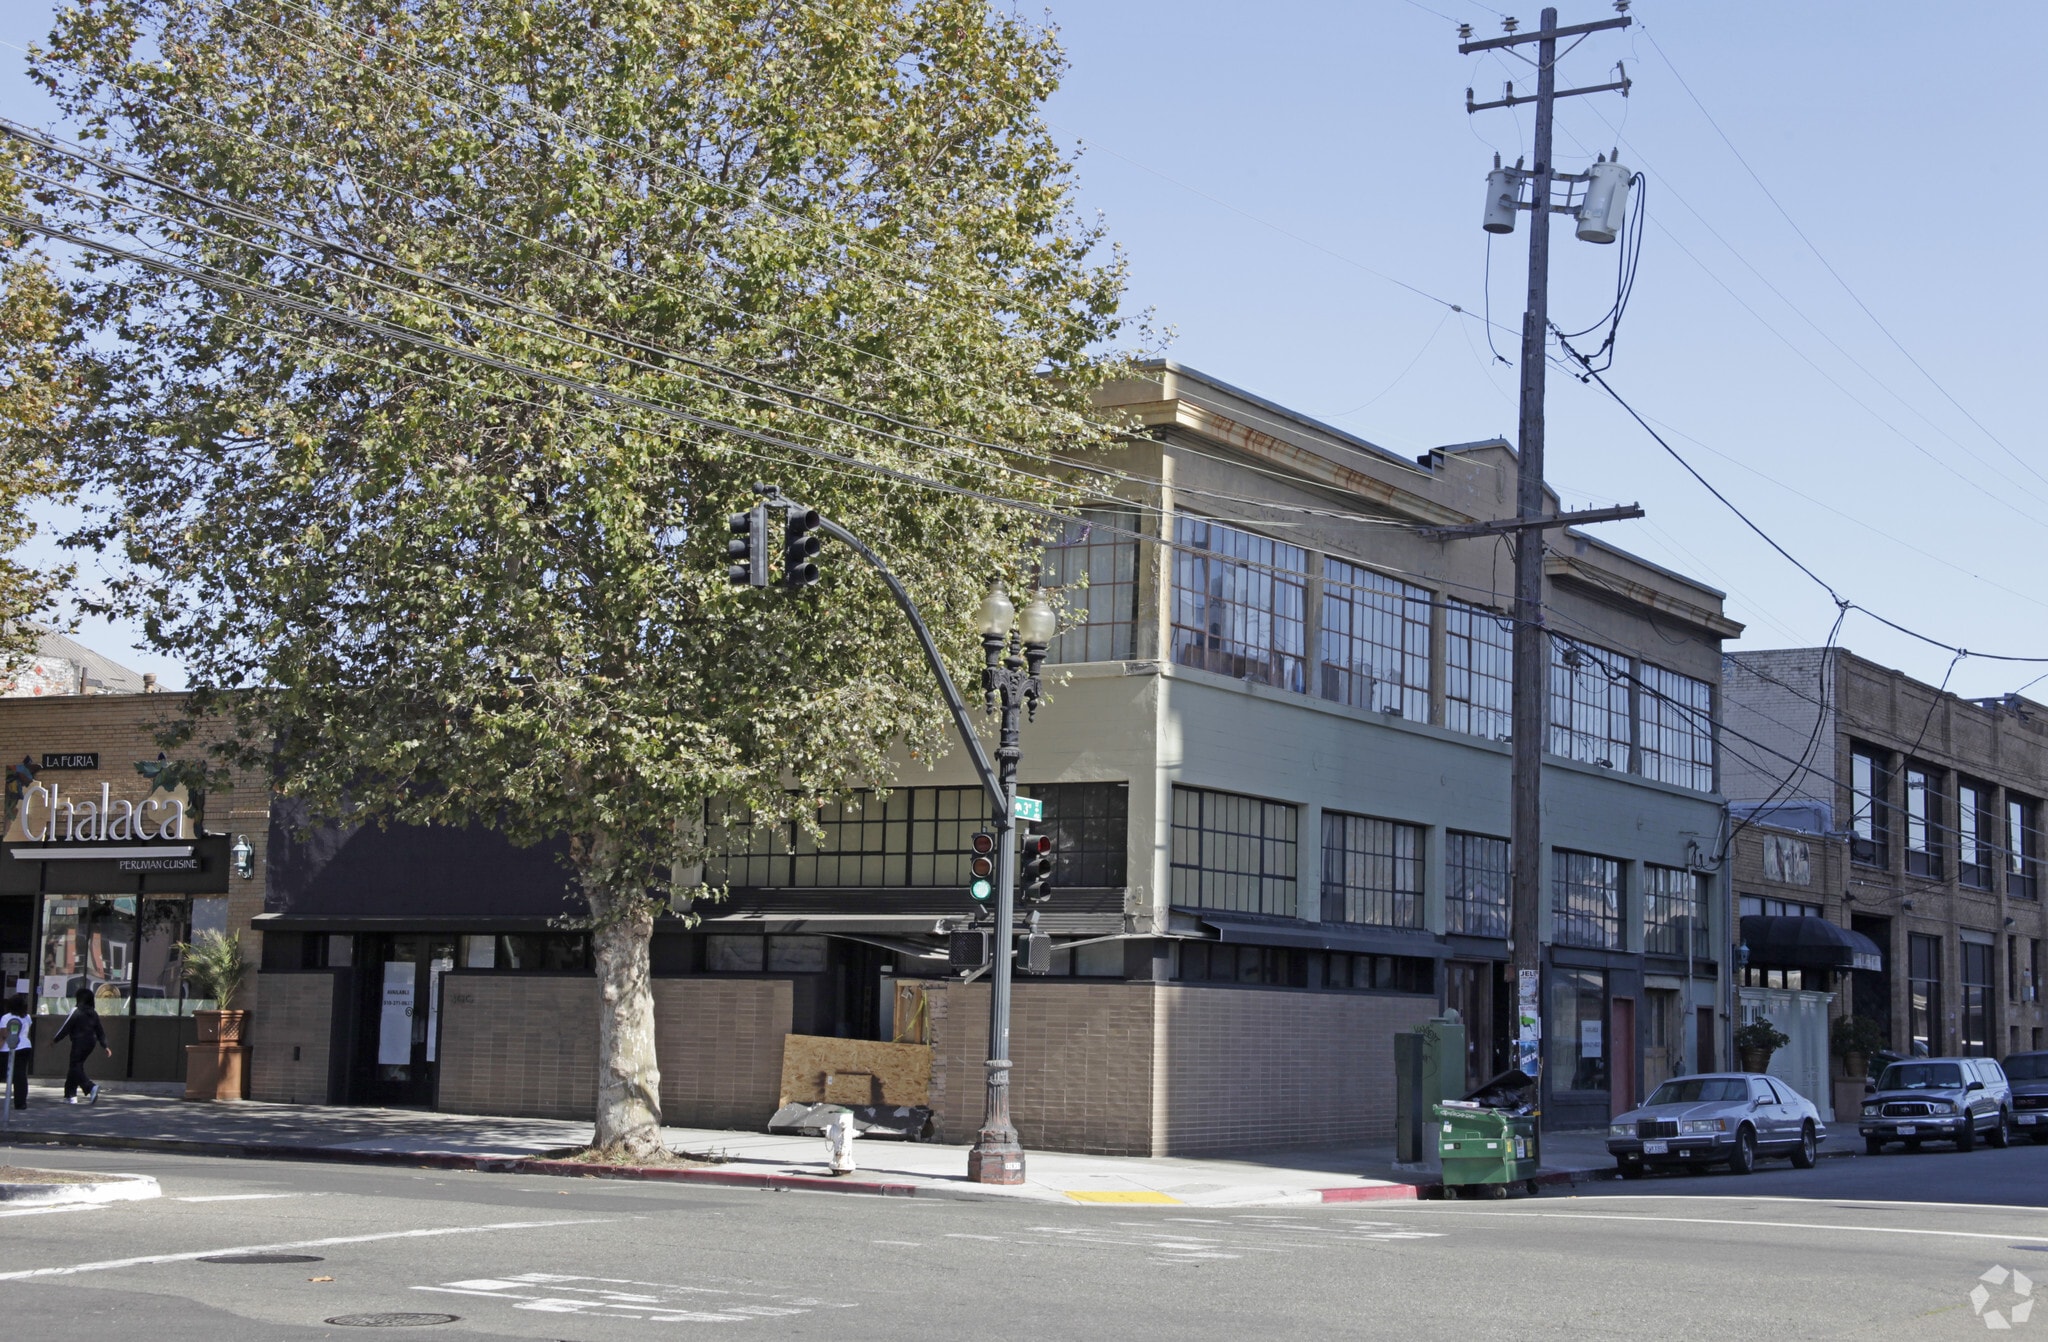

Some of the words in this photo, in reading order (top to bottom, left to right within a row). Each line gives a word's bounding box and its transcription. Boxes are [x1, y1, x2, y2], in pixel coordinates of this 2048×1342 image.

[60, 755, 94, 767] FURIA
[21, 782, 185, 842] Chalaca
[119, 860, 162, 870] PERUVIAN
[162, 859, 198, 869] CUISINE
